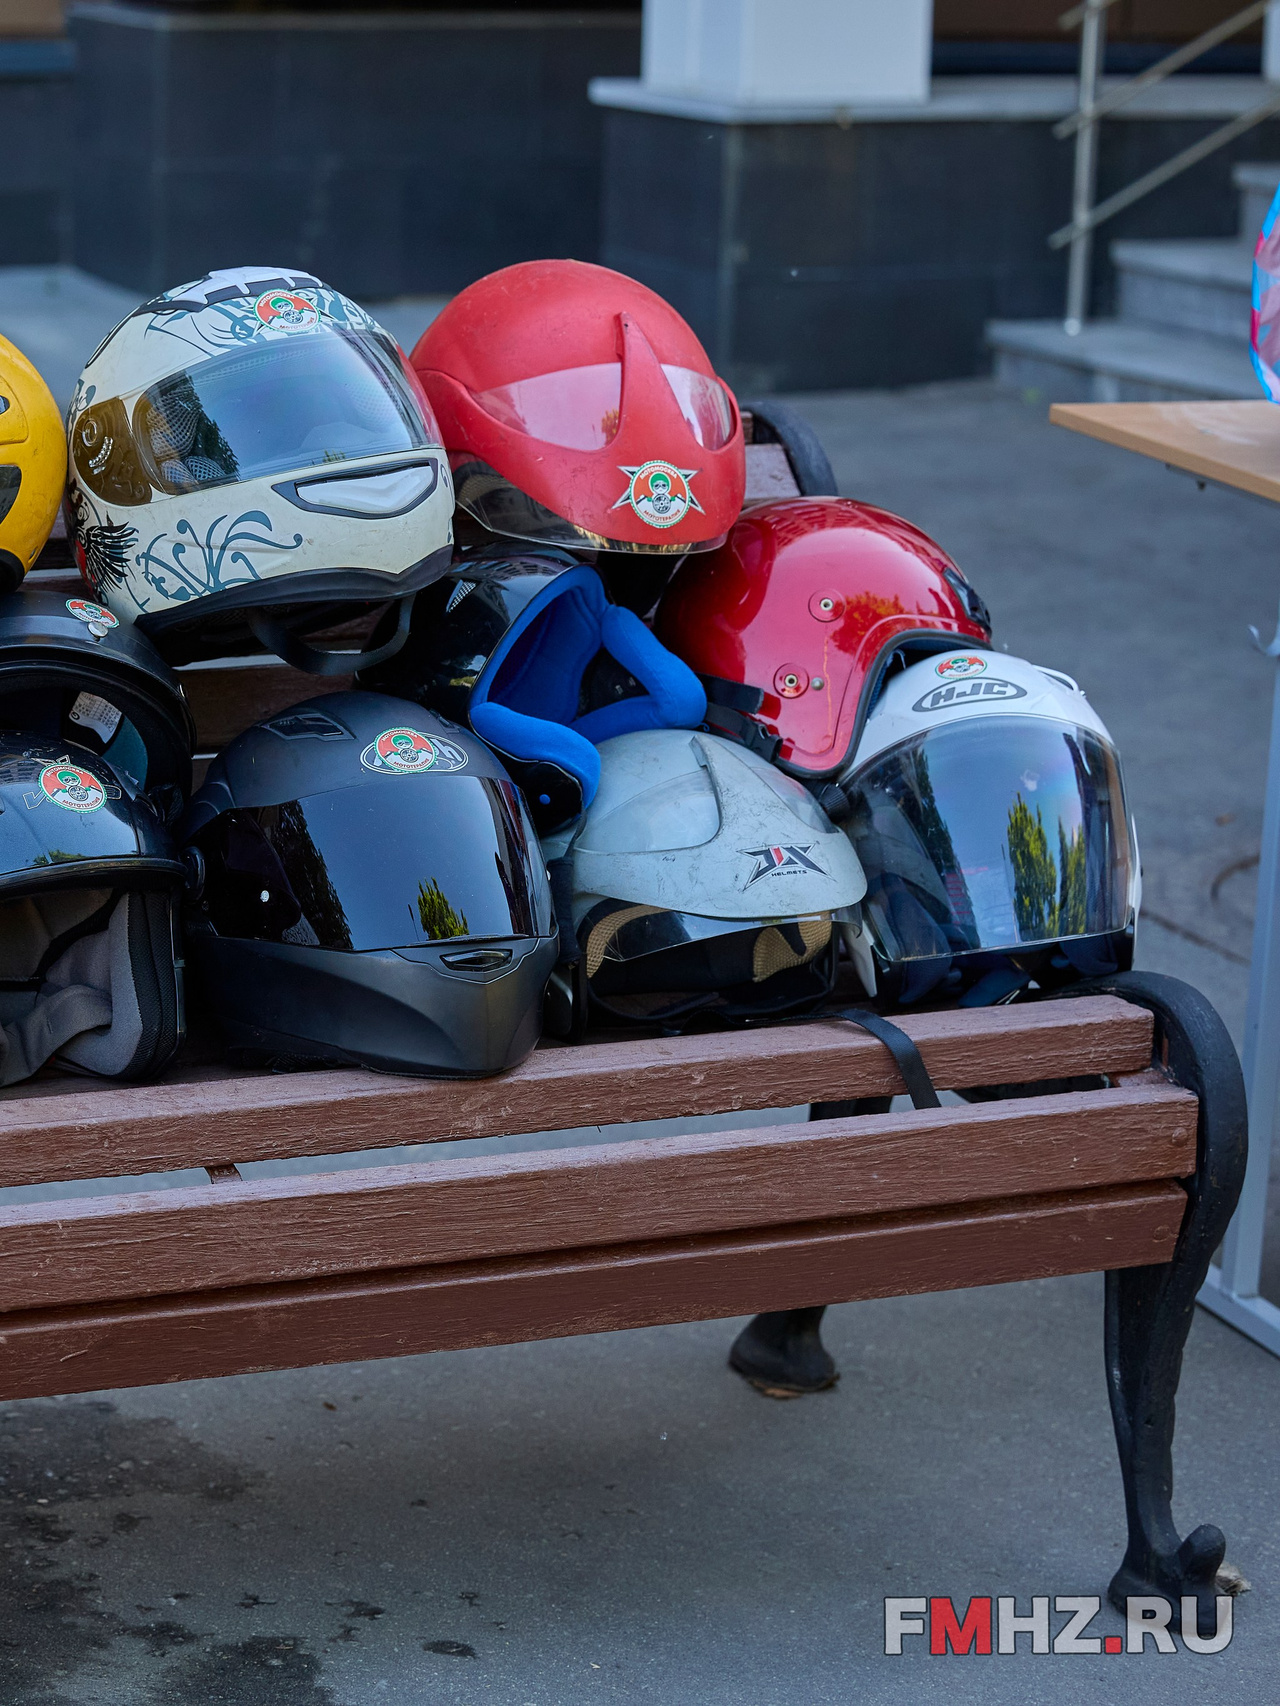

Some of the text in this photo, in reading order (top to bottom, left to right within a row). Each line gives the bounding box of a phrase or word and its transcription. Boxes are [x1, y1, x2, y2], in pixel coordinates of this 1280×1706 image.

[640, 466, 677, 480] МОТОМОСКВА
[644, 509, 681, 522] МОТОТЕРАПИЯ
[930, 683, 1009, 708] HJC
[381, 729, 418, 742] МОТОМОСКВА
[771, 869, 808, 877] HELMETS
